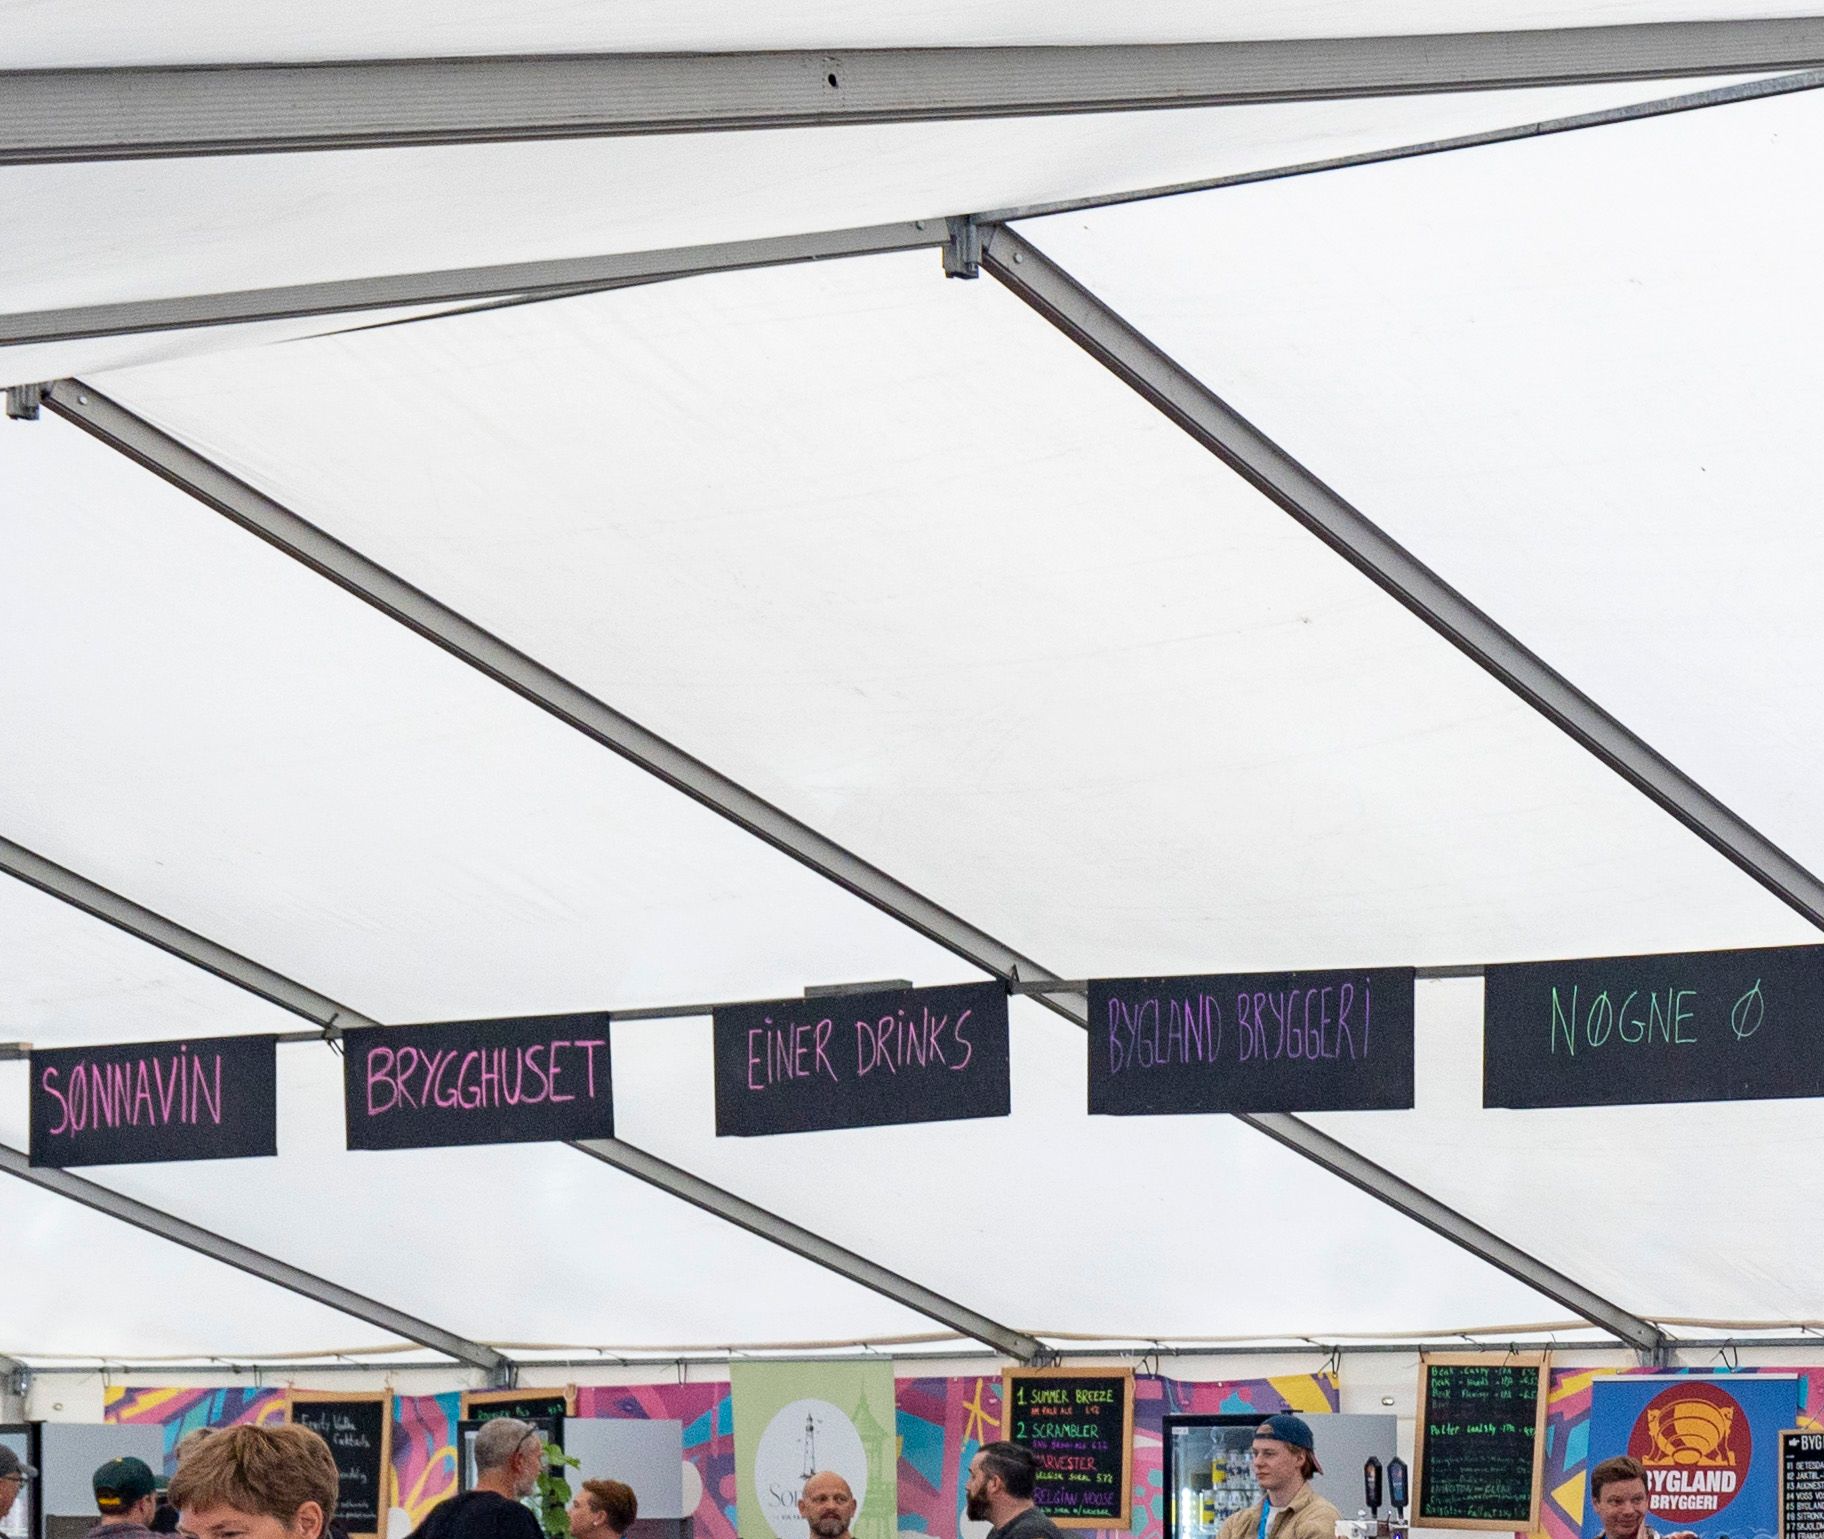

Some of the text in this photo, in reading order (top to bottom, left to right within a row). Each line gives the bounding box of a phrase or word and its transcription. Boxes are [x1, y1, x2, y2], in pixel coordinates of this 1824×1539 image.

[1107, 994, 1220, 1074] BYGLAND
[1551, 977, 1765, 1056] NØGNE Ø
[367, 1039, 606, 1116] BRYGGHUSET
[1030, 1389, 1069, 1405] SUMMER
[1075, 1389, 1114, 1405] BREEZE
[1017, 1421, 1099, 1439] 2 SCRAMBLER
[1649, 1494, 1718, 1510] BRYGGERI
